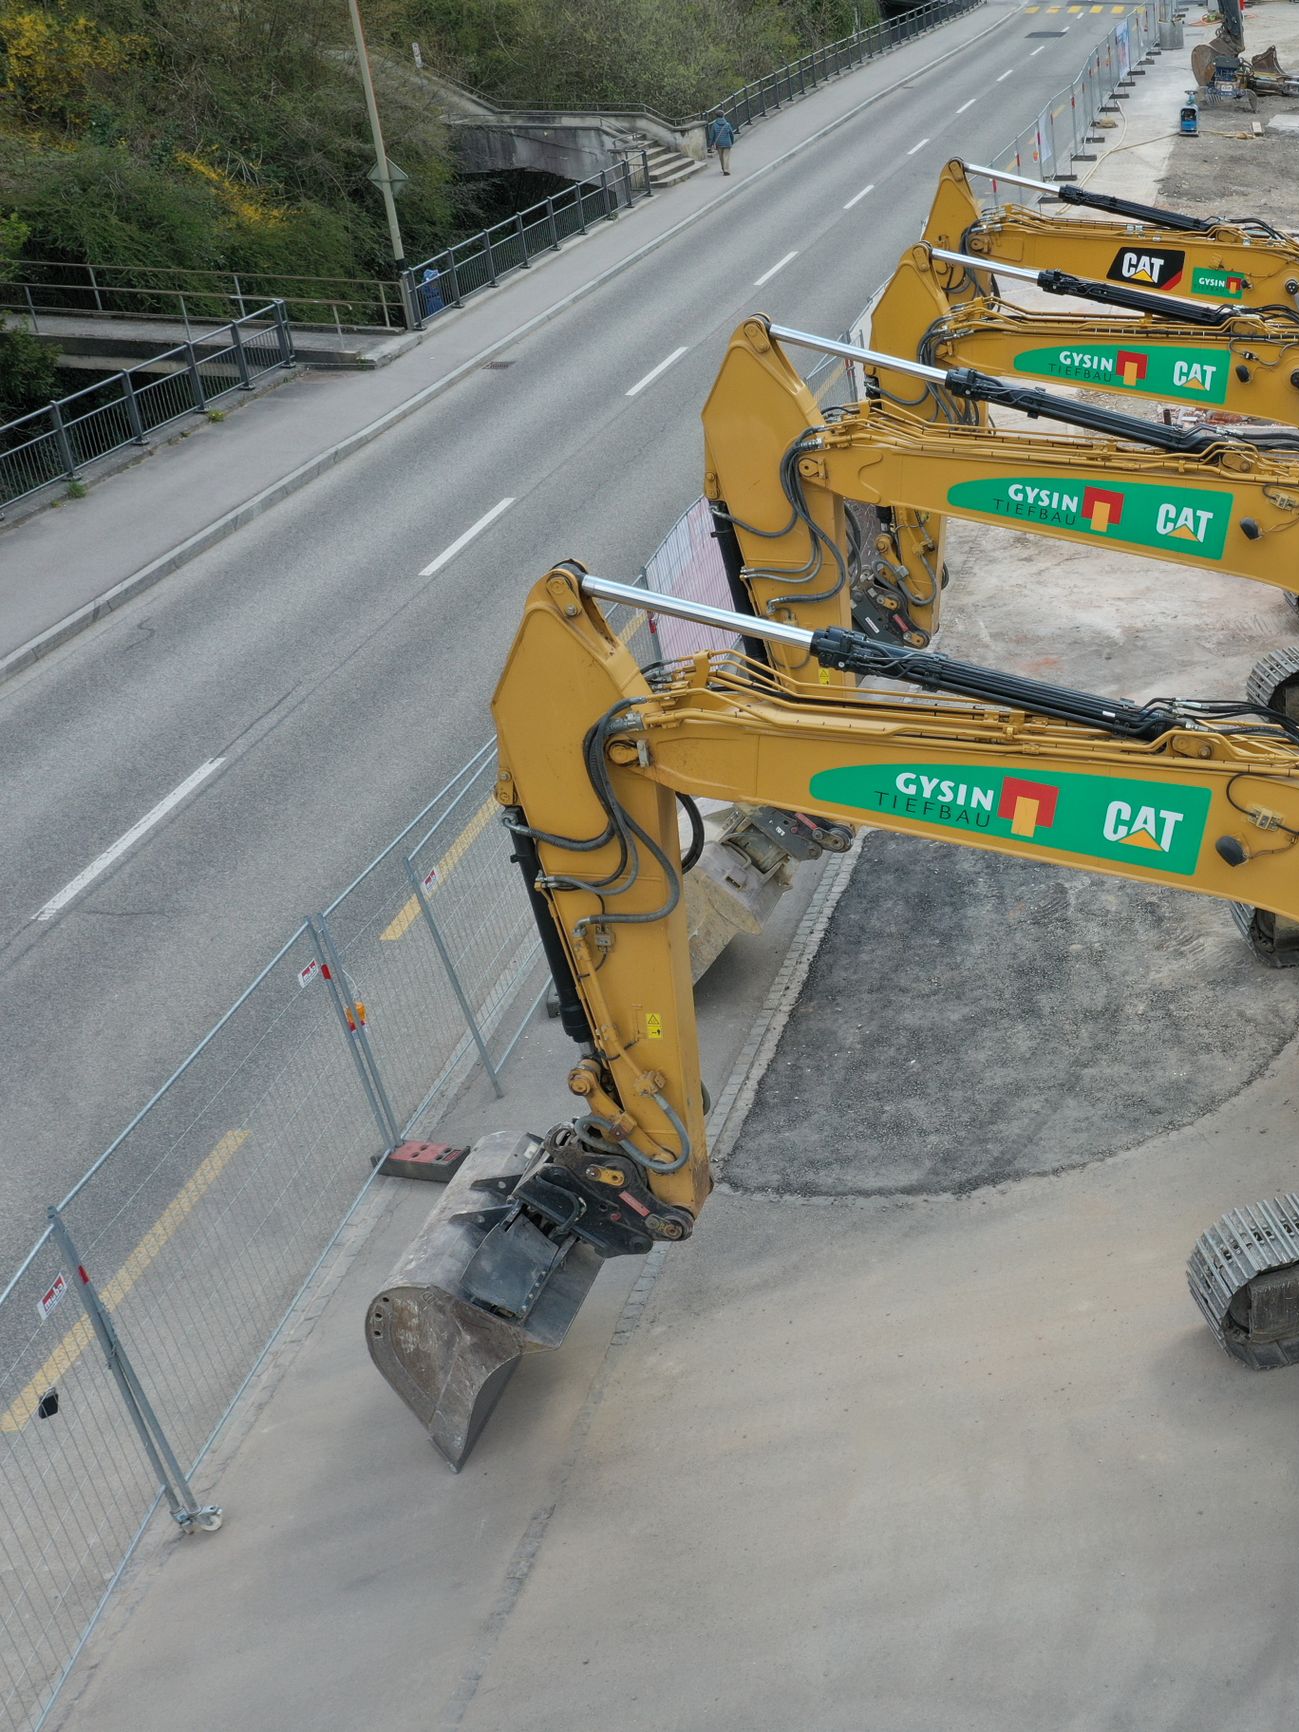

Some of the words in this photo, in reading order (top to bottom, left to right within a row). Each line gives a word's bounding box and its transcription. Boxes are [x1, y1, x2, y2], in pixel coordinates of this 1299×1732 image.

[1122, 252, 1165, 283] CAT
[1199, 277, 1226, 288] GYSIN
[1049, 363, 1113, 383] TIEFBAU
[1059, 350, 1114, 372] GYSIN
[1173, 360, 1217, 392] CAT
[993, 498, 1076, 526] TIEFBAU
[1008, 483, 1079, 513] GYSIN
[1156, 503, 1214, 543] CAT
[895, 772, 995, 811] GYSIN
[874, 790, 991, 828] TIEFBAU
[1103, 800, 1184, 853] CAT
